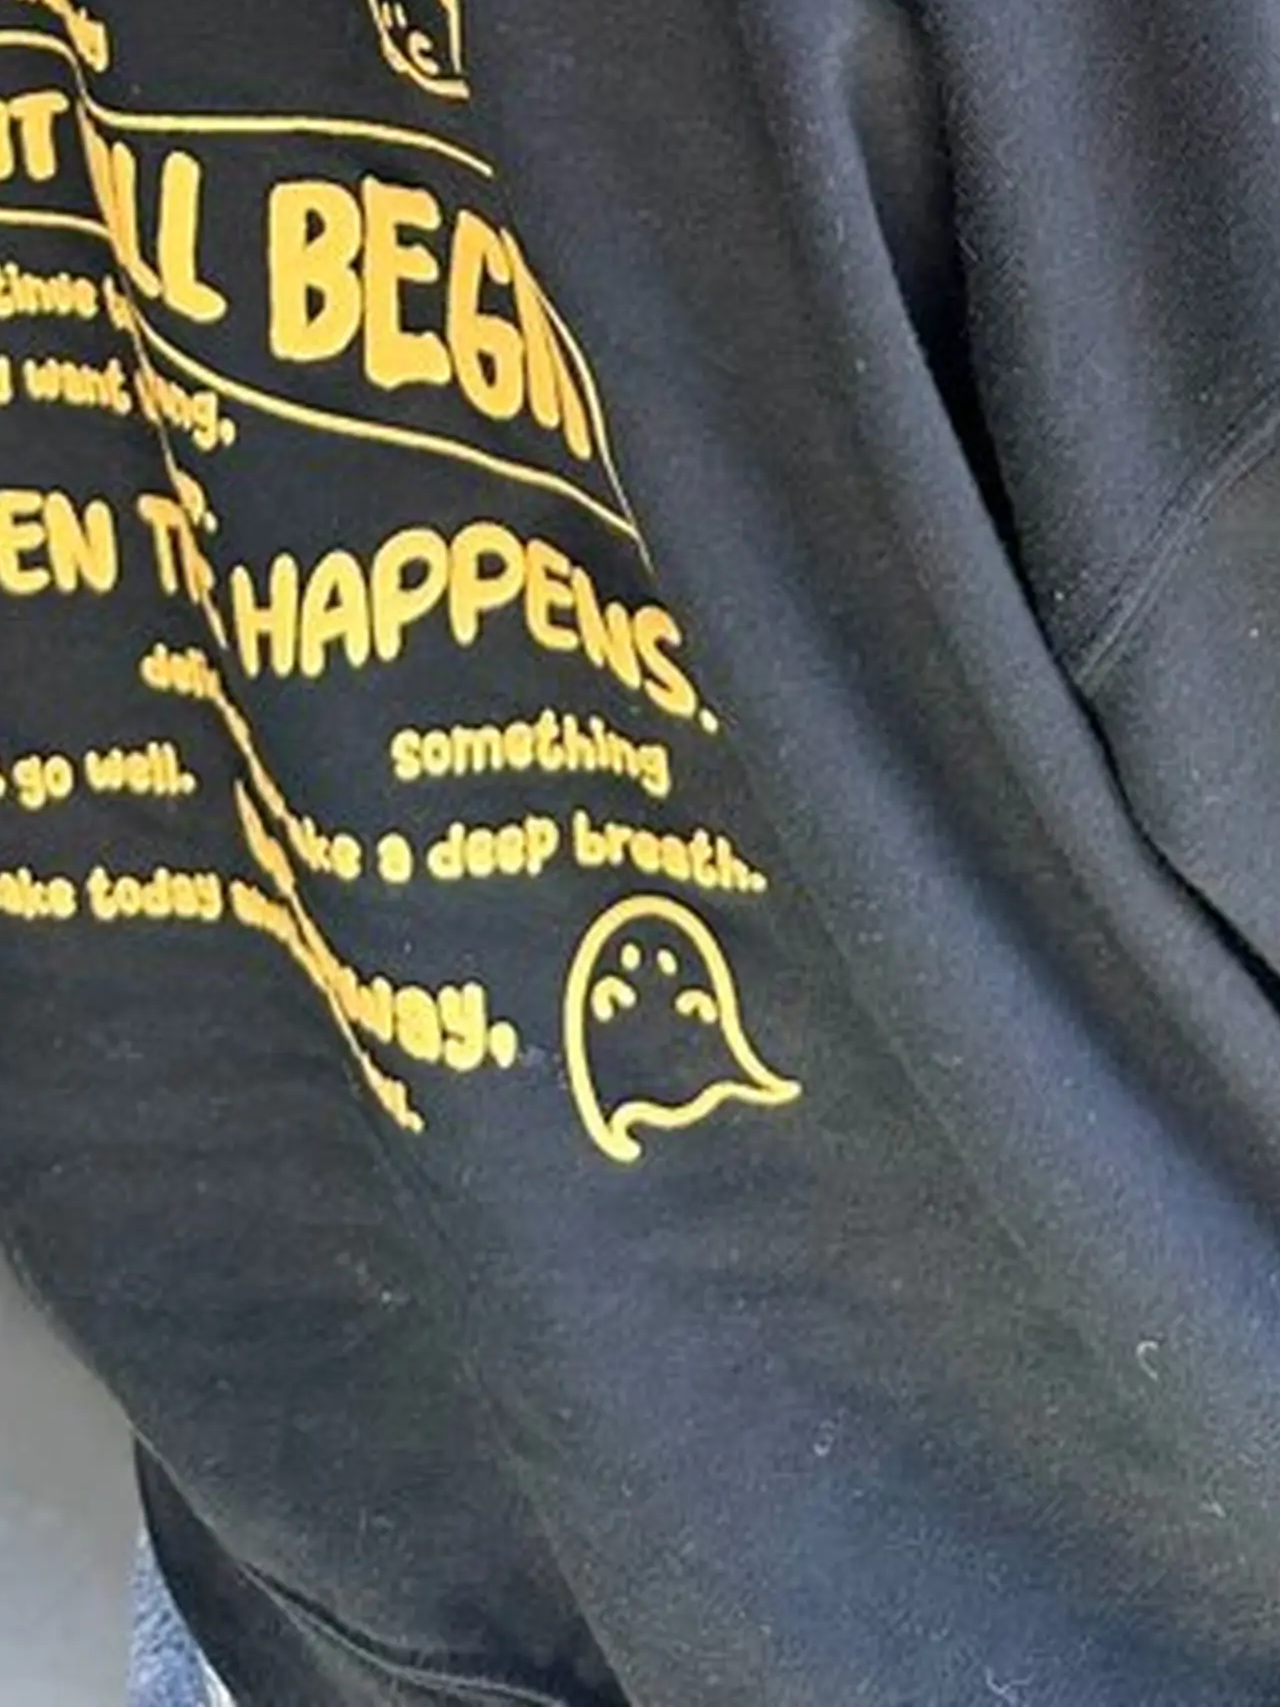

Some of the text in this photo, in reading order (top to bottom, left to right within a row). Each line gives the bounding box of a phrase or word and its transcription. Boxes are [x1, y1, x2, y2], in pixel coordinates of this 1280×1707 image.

[231, 521, 718, 734] HAPPENS.
[12, 754, 73, 810] go
[84, 741, 197, 797] well.
[391, 708, 670, 798] something
[377, 833, 413, 884] a
[427, 815, 559, 881] deep
[572, 810, 767, 893] breath.
[86, 867, 223, 921] today
